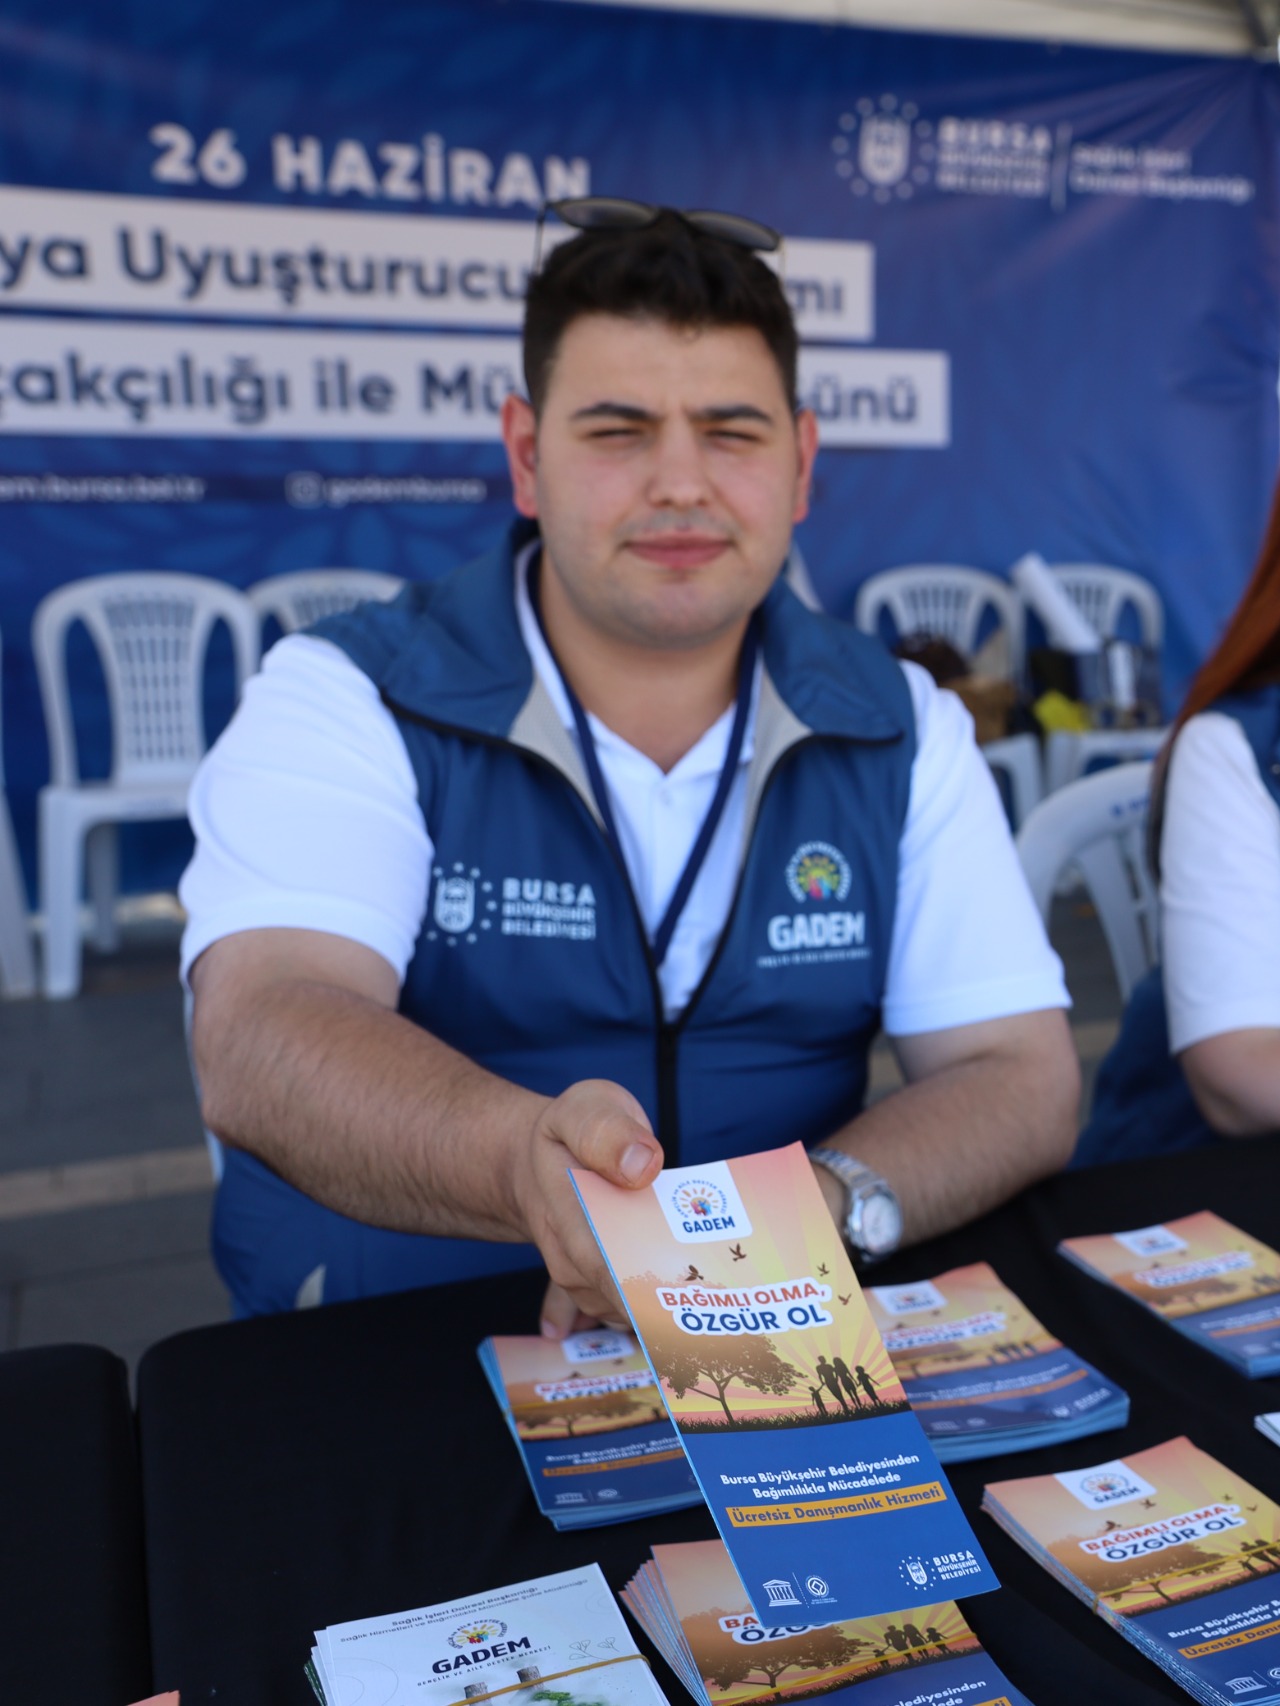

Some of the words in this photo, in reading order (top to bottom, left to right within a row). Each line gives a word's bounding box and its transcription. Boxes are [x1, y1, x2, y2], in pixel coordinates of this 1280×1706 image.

[149, 122, 248, 188] 26
[272, 132, 592, 208] HAZİRAN
[116, 224, 530, 306] Uyuşturucu
[0, 350, 290, 427] akçılığı
[315, 357, 395, 416] ile
[798, 373, 920, 425] ünü
[502, 877, 596, 906] BURSA
[767, 911, 866, 952] GADEM
[682, 1215, 736, 1233] GADEM
[662, 1289, 752, 1308] BAĞIMLI
[753, 1282, 826, 1305] OLMA,
[681, 1307, 782, 1332] ÖZGÜR
[787, 1304, 828, 1326] OL
[720, 1473, 757, 1486] Bursa
[757, 1468, 827, 1485] Büyükşehir
[828, 1453, 921, 1478] Belediyesinden
[752, 1484, 826, 1500] Bağımlılıkla
[827, 1471, 902, 1493] Mücadelede
[1092, 1486, 1141, 1504] GADEM
[732, 1505, 792, 1525] Ücretsiz
[793, 1497, 884, 1519] Danışmanlık
[884, 1485, 943, 1508] Hizmeti
[1085, 1522, 1170, 1551] BAĞIMLI
[1171, 1504, 1236, 1528] OLMA,
[1105, 1527, 1197, 1561] ÖZGÜR
[1203, 1514, 1241, 1533] OL
[932, 1550, 975, 1567] BURSA
[940, 1565, 981, 1581] BELEDİYESİ
[391, 1615, 423, 1627] Sağlık
[424, 1608, 449, 1620] İşleri
[1168, 1623, 1205, 1639] Bursa
[1204, 1603, 1270, 1630] Büyükşehir
[431, 1636, 532, 1674] GADEM
[518, 1644, 553, 1658] MERKEZİ
[1184, 1636, 1243, 1656] Ücretsiz
